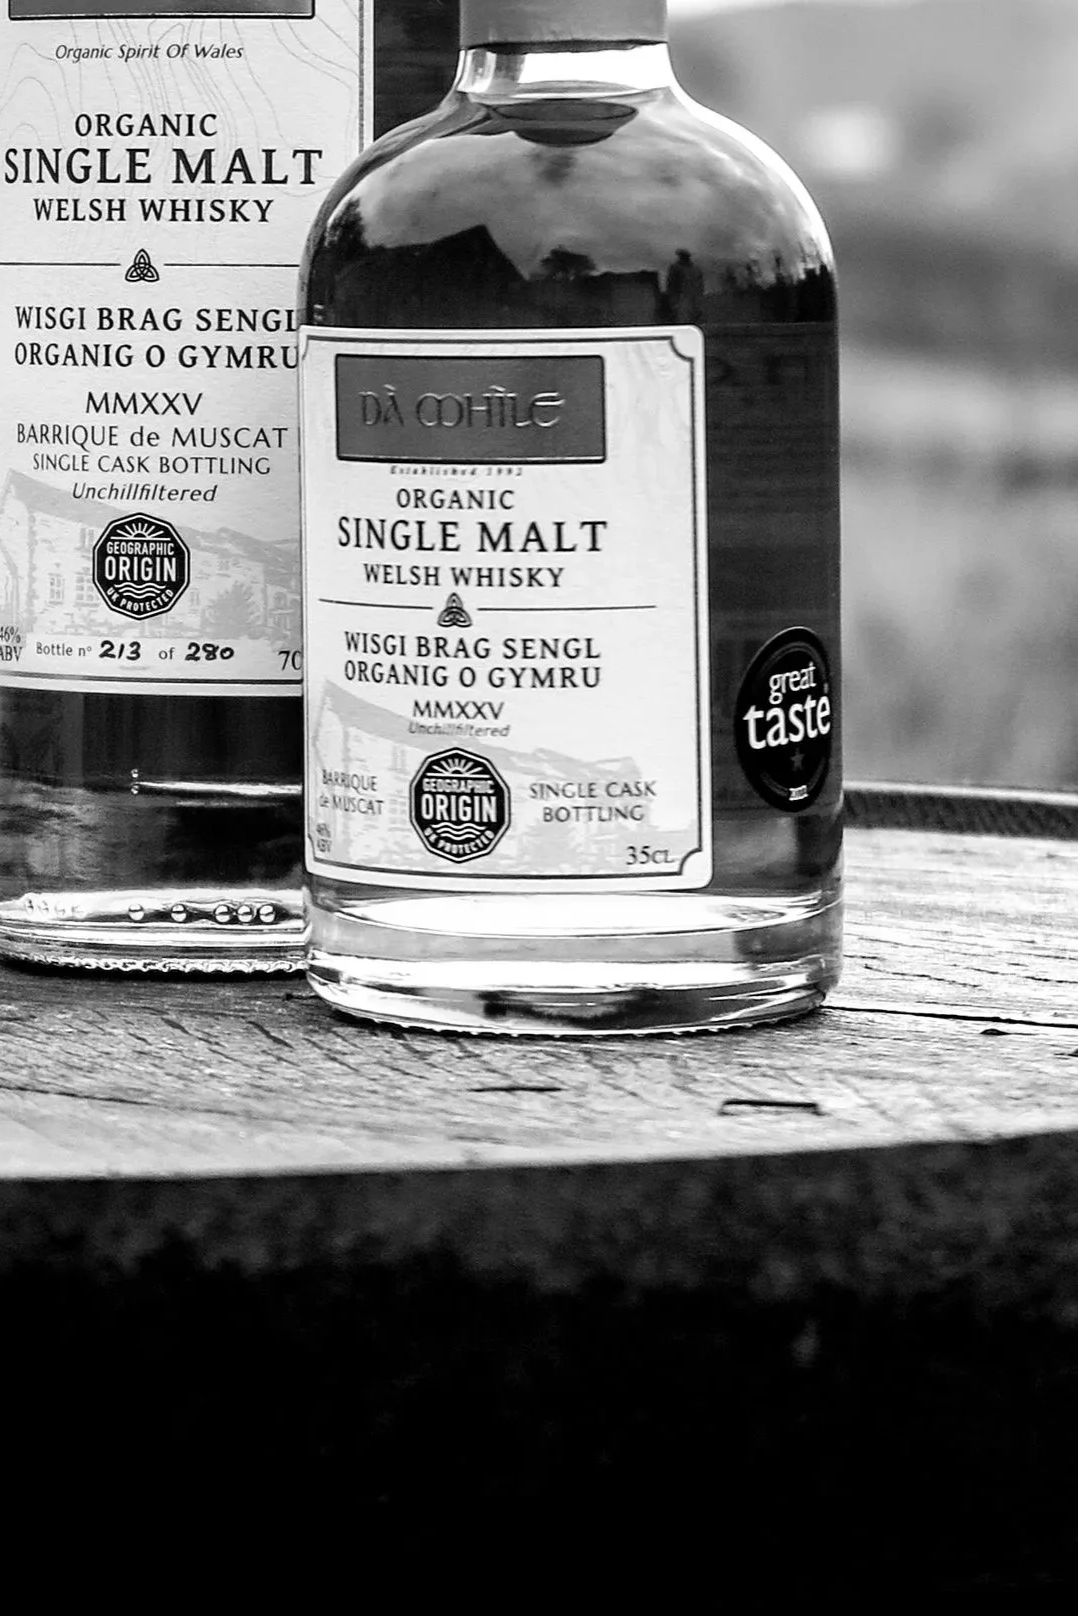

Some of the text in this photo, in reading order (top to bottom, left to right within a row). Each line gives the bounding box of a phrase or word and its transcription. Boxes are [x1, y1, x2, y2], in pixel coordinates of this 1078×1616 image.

[55, 44, 244, 64] Organic Spirit Of Wales
[75, 113, 218, 137] ORGANIC
[4, 148, 322, 185] SINGLE MALT
[33, 197, 274, 223] WELSH WHISKY
[15, 306, 298, 332] WISGI BRAG SENGL
[15, 342, 299, 370] ORGANIG O GYMRU
[85, 391, 203, 416] MMXXV
[17, 423, 288, 453] BARRIQUE de MUSCAT
[32, 453, 271, 476] SINGLE CASK BOTTLING
[72, 482, 218, 503] Unchillfiltered
[397, 488, 515, 510] ORGANIC
[338, 516, 608, 553] SINGLE MALT
[106, 541, 175, 555] GEOGRAPHIC
[105, 556, 176, 582] ORIGIN
[363, 562, 564, 588] WELSH WHISKY
[106, 587, 174, 612] UK PROTECTED
[36, 642, 73, 657] Bottle
[98, 640, 141, 661] 213
[158, 647, 176, 660] of
[185, 642, 235, 662] 280
[344, 631, 602, 660] WISGI BRAG SENGL
[344, 660, 602, 688] ORGANIG O GYMRU
[769, 661, 817, 705] great
[412, 699, 505, 720] MMXXV
[742, 694, 831, 750] taste
[529, 781, 656, 799] SINGLE CASK
[422, 793, 497, 823] ORIGIN
[542, 805, 645, 823] BOTTLING
